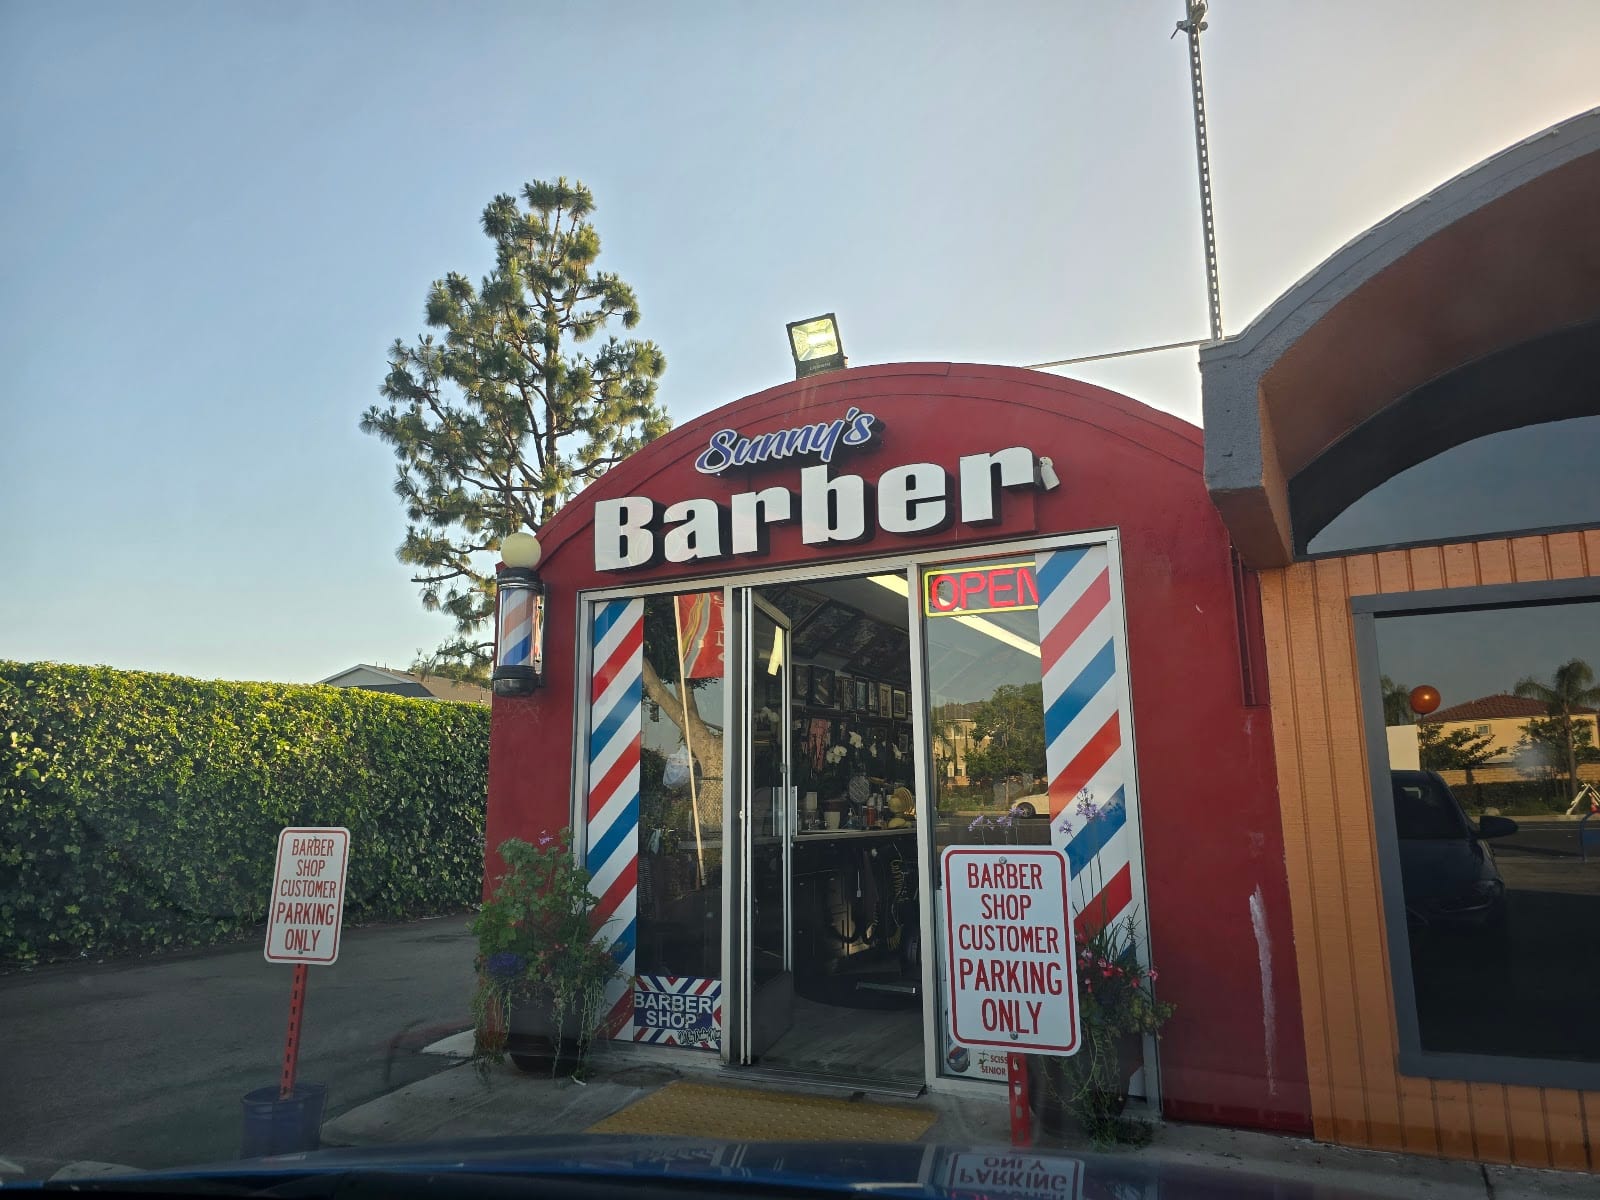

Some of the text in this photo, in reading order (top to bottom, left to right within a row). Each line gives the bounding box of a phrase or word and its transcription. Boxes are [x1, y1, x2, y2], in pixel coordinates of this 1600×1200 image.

[694, 405, 876, 476] Sunny's
[594, 445, 1036, 573] Barber
[291, 838, 335, 857] BARBER
[296, 859, 326, 878] SHOP
[967, 862, 1043, 890] BARBER
[280, 879, 337, 899] CUSTOMER
[276, 902, 335, 926] PARKING
[981, 893, 1032, 921] SHOP
[284, 928, 321, 952] ONLY
[958, 923, 1060, 954] CUSTOMER
[959, 958, 1063, 996] PARKING
[634, 992, 713, 1014] BARBER
[646, 1010, 697, 1029] SHOP
[981, 998, 1043, 1035] ONLY
[990, 1054, 1008, 1065] SCISS
